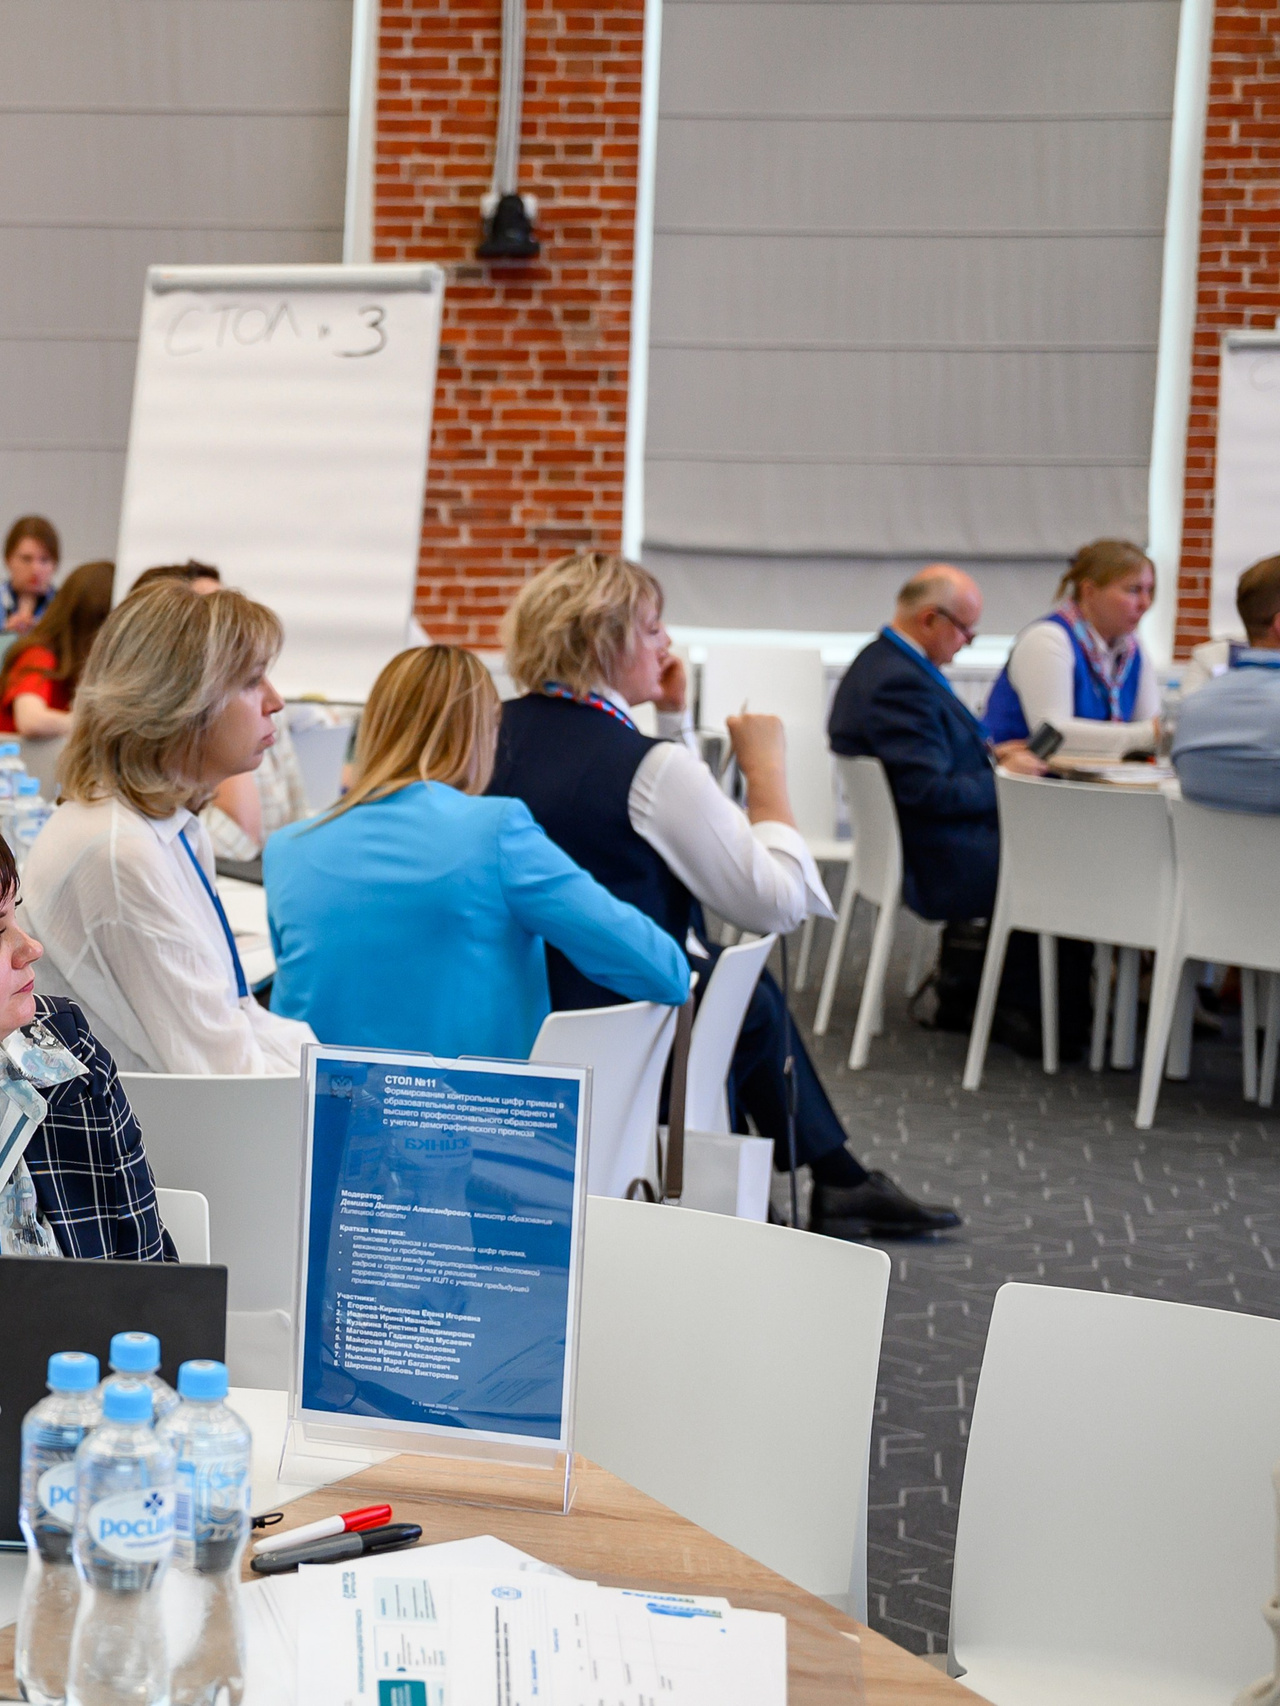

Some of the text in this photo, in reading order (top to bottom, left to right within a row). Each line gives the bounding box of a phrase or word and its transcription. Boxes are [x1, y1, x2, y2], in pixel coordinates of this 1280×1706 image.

[385, 1075, 436, 1088] СТОЛ №11
[384, 1087, 445, 1098] Формирование
[447, 1093, 500, 1104] контрольных
[502, 1098, 524, 1106] цифр
[526, 1100, 557, 1108] приема
[384, 1097, 455, 1110] образовательные
[457, 1104, 508, 1114] организации
[510, 1108, 548, 1118] среднего
[384, 1108, 558, 1129] высшего профессионального образования
[420, 1122, 496, 1133] демографического
[498, 1128, 535, 1137] прогноза
[342, 1190, 384, 1200] Модератор:
[374, 1202, 410, 1212] Дмитрий
[474, 1212, 506, 1221] министр
[507, 1214, 552, 1225] образования
[375, 1211, 406, 1220] области
[340, 1224, 406, 1236] Краткая тематика:
[337, 1292, 376, 1302] Участники:
[347, 1302, 420, 1316] Егорова-Кириллова
[446, 1312, 480, 1322] Игоревна
[347, 1310, 378, 1319] Иванова
[380, 1314, 403, 1322] Ирина
[404, 1317, 441, 1326] Ивановна
[384, 1323, 418, 1332] Кристина
[420, 1326, 475, 1338] Владимировна
[384, 1340, 412, 1348] Марина
[414, 1344, 456, 1354] Федоровна
[378, 1348, 402, 1356] Ирина
[403, 1350, 460, 1362] Александровна
[415, 1369, 459, 1380] Викторовна
